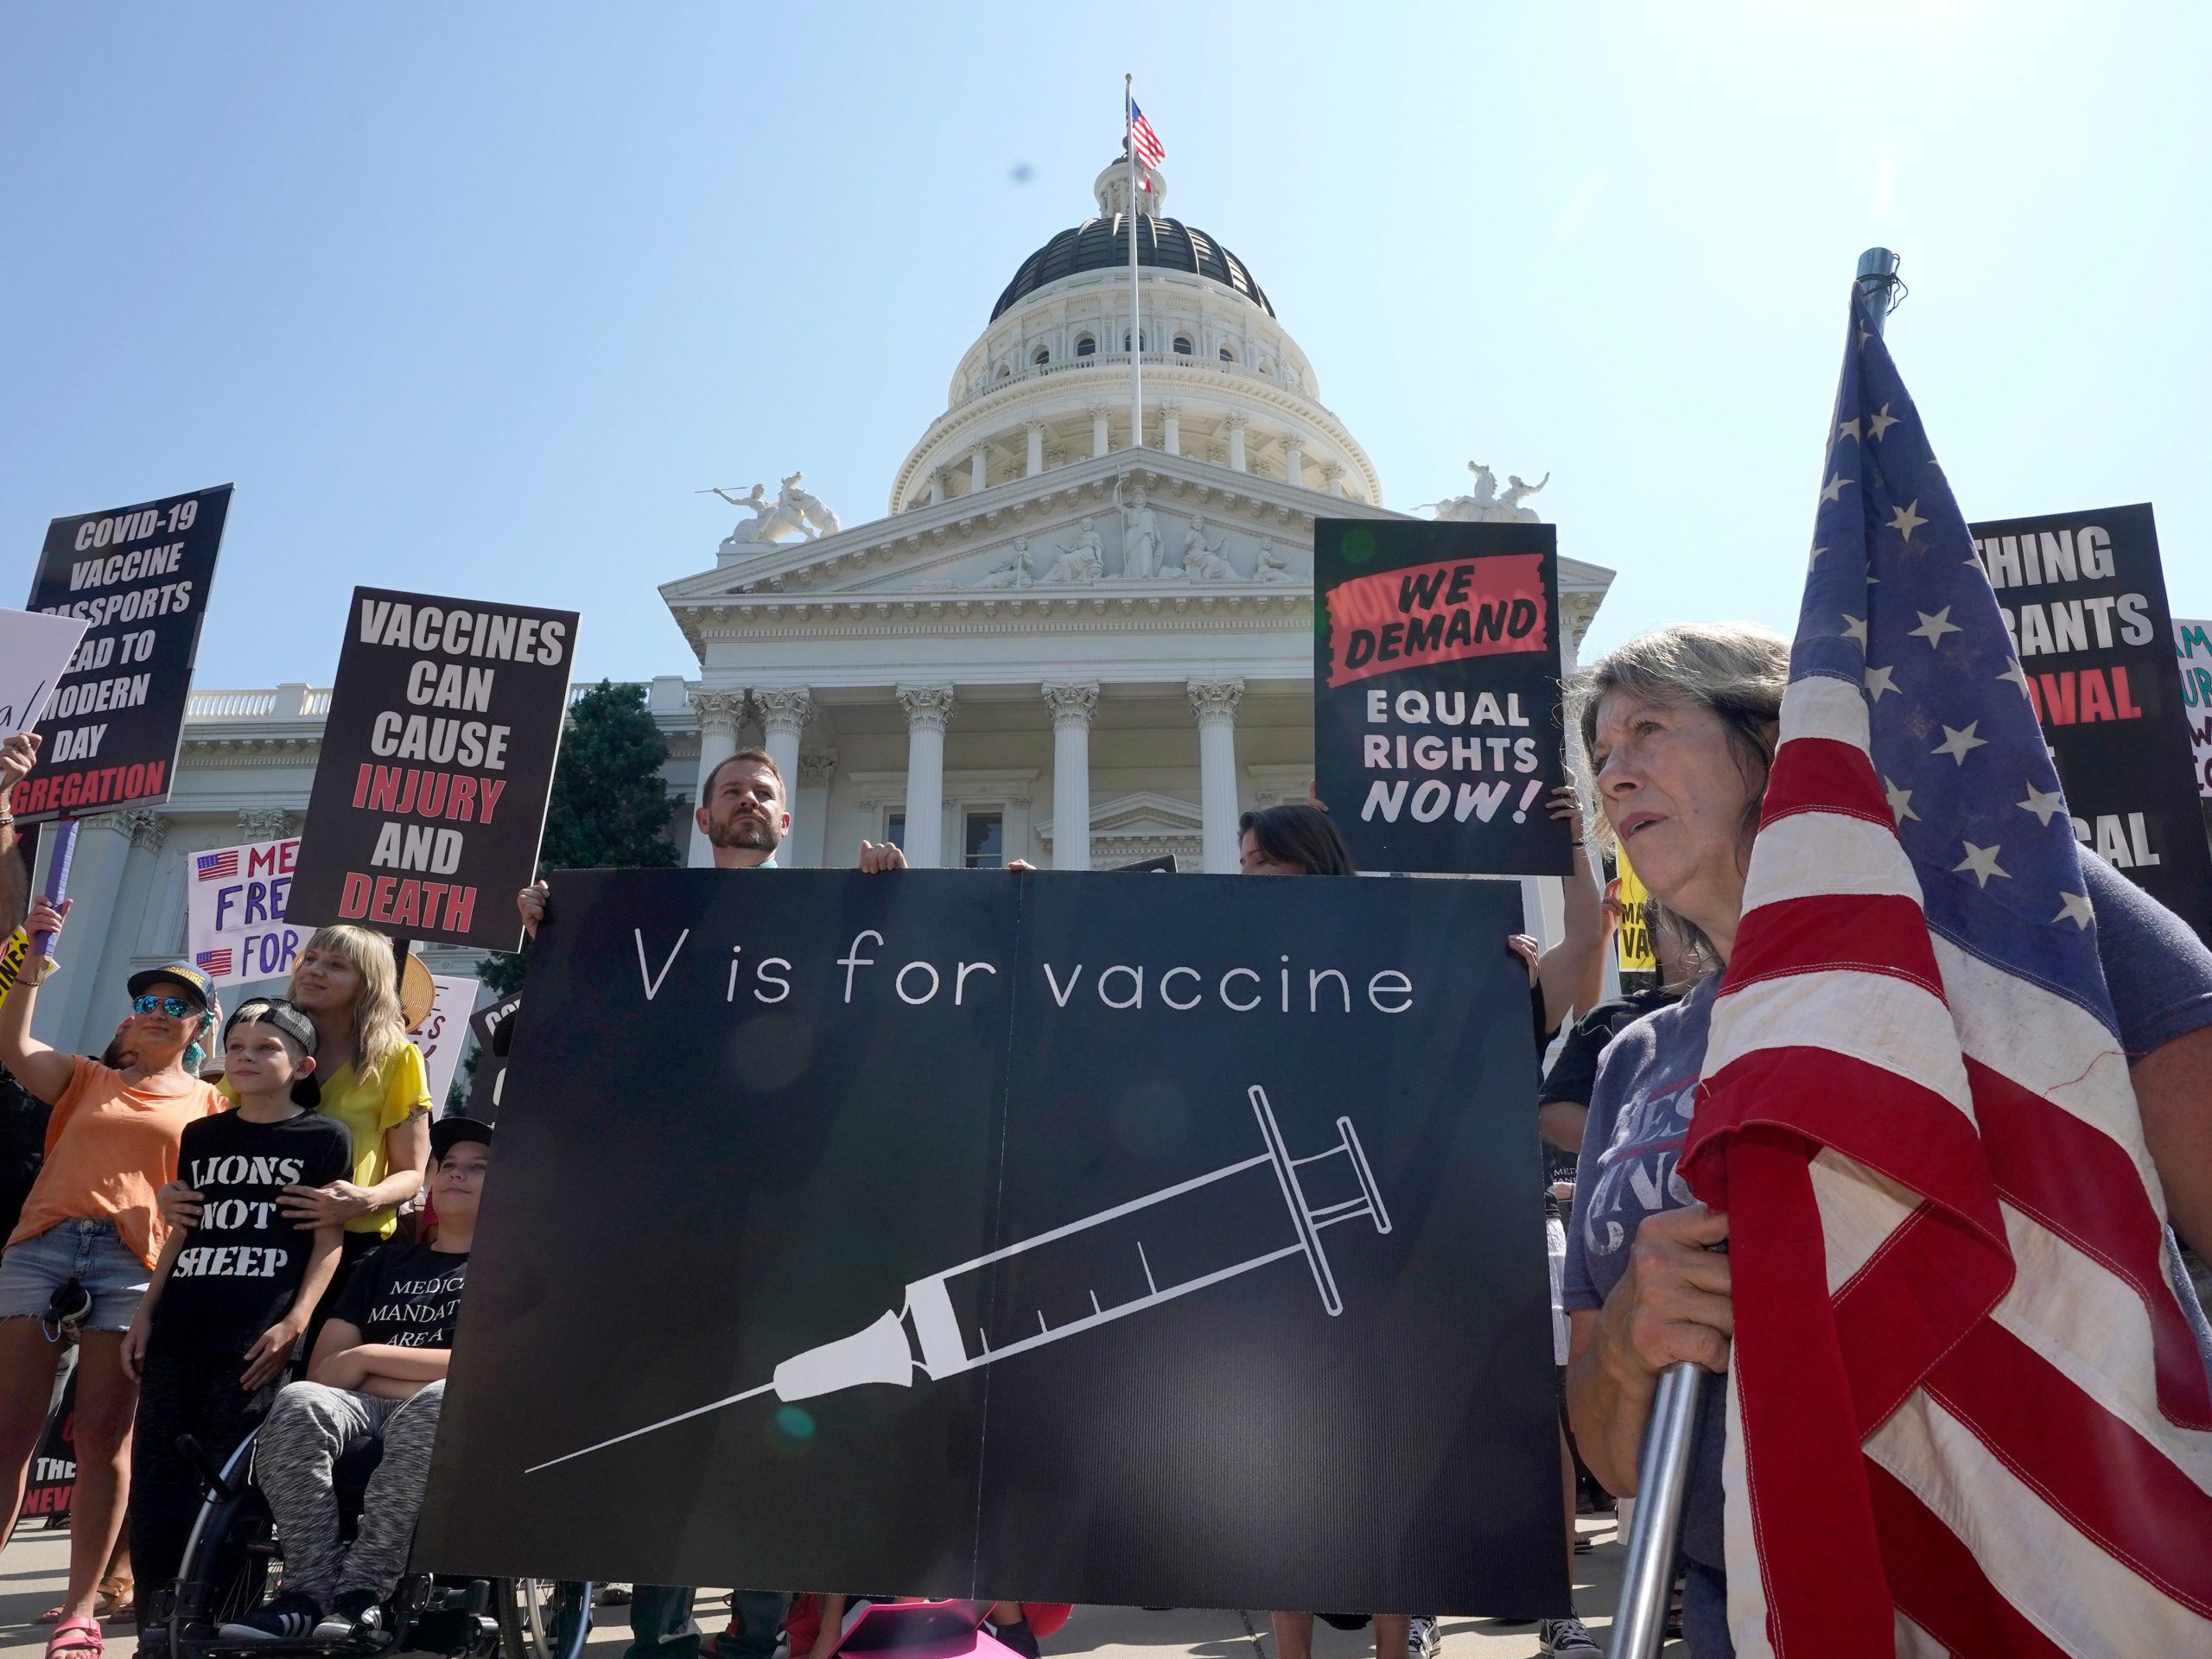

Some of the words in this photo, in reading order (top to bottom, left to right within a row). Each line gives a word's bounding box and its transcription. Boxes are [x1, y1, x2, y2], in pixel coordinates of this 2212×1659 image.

[74, 499, 199, 551] COVID-19
[69, 542, 185, 591] VACCINE
[1397, 564, 1475, 614] WE
[41, 581, 193, 629] SSPORTS
[120, 629, 156, 665] TO
[359, 599, 566, 666] VACCINES
[1344, 598, 1537, 670] DEMAND
[406, 660, 495, 713] CAN
[1367, 690, 1529, 727] EQUAL
[50, 723, 108, 765] DAY
[371, 711, 511, 771] CAUSE
[1363, 734, 1538, 773] RIGHTS
[10, 760, 166, 816] GREGATION
[352, 763, 506, 824] INJURY
[1360, 779, 1543, 824] NOW!
[247, 841, 301, 878] ME
[370, 822, 464, 875] AND
[216, 877, 293, 931] FRE
[338, 872, 477, 933] DEATH
[242, 929, 299, 976] FOR
[634, 927, 690, 1000] V
[727, 945, 792, 1003] is
[836, 930, 996, 1006] for
[1043, 955, 1414, 1014] vaccine
[191, 1155, 305, 1190] LIONS
[200, 1198, 276, 1231] NOT
[172, 1246, 289, 1278] SHEEP
[390, 1277, 465, 1295] MEDIC
[367, 1299, 461, 1324] MANDAT
[385, 1332, 429, 1347] ARE
[429, 1327, 443, 1341] A
[35, 1457, 77, 1481] THE
